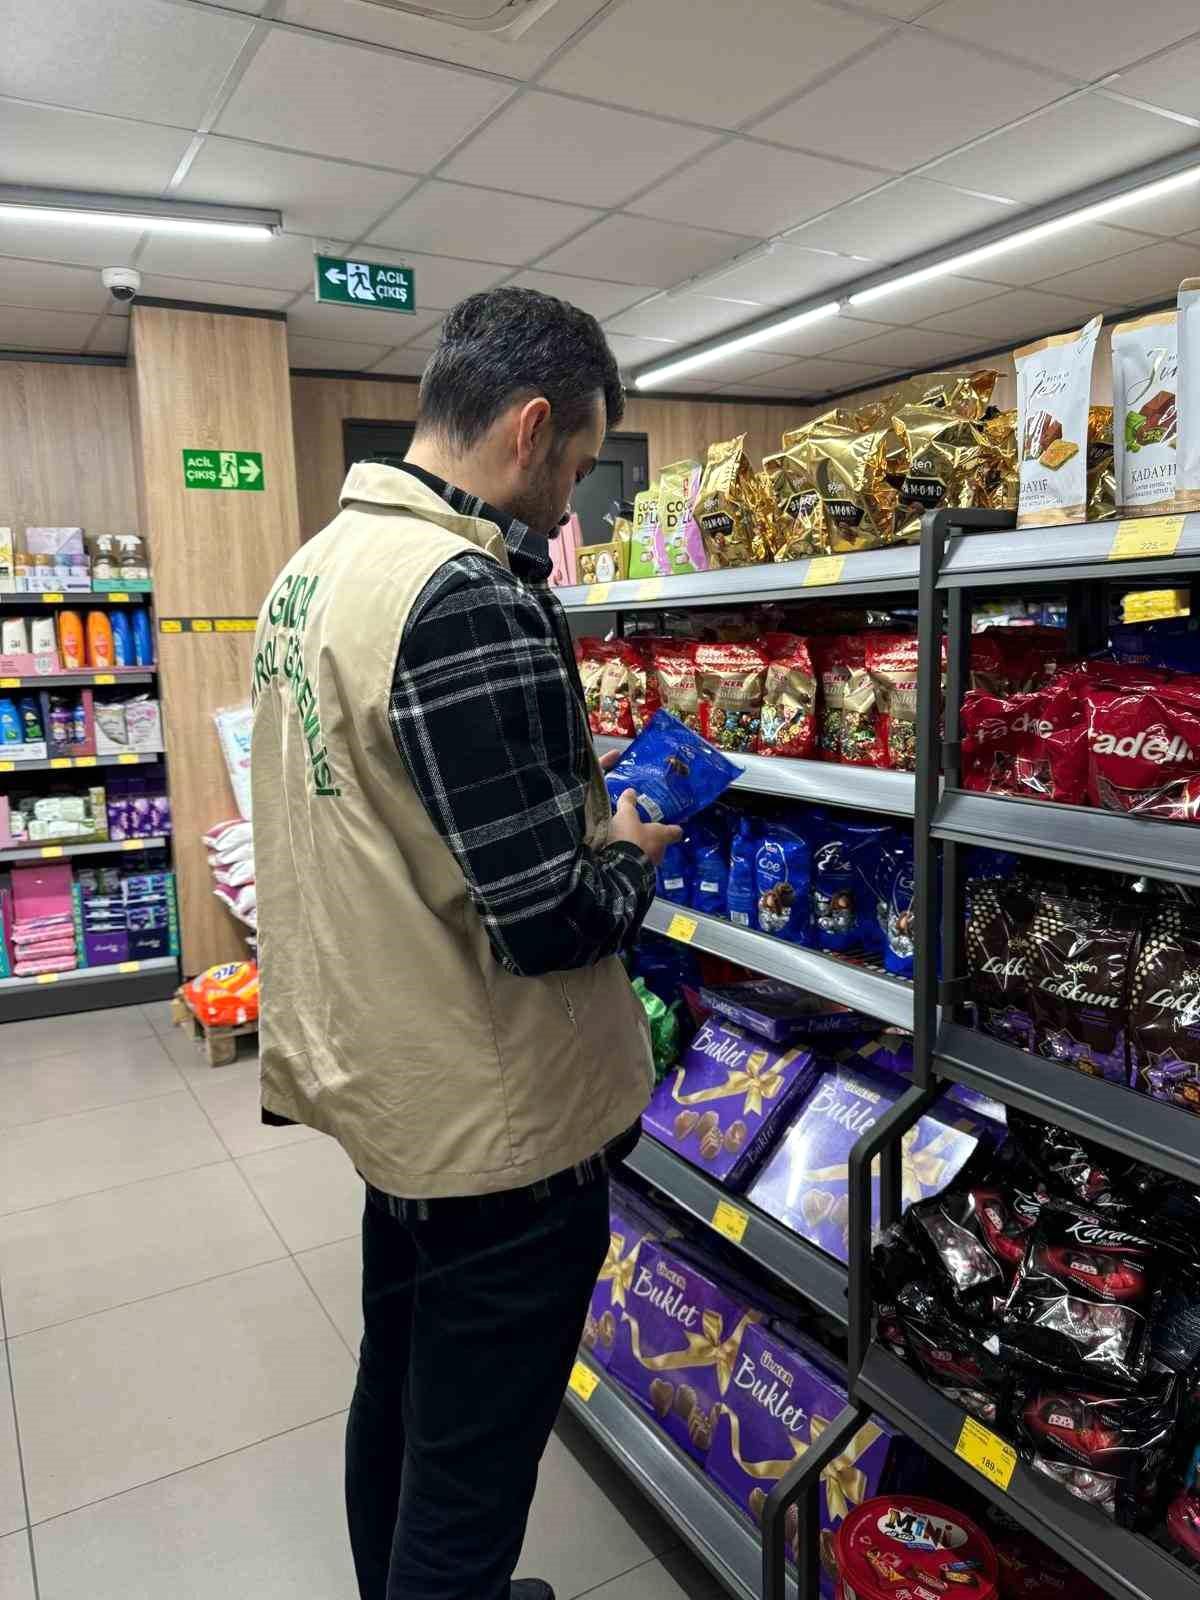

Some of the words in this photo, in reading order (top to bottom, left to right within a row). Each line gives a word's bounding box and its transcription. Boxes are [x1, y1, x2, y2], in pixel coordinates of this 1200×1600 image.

[376, 285, 408, 303] ÇIKIŞ
[186, 470, 216, 483] ÇIKIŞ
[252, 635, 279, 708] ROL
[1039, 976, 1120, 1009] Lokkum
[691, 1018, 749, 1068] Buklet
[807, 1083, 876, 1136] Bukle
[632, 1265, 701, 1328] Buklet
[734, 1351, 808, 1432] Buklet
